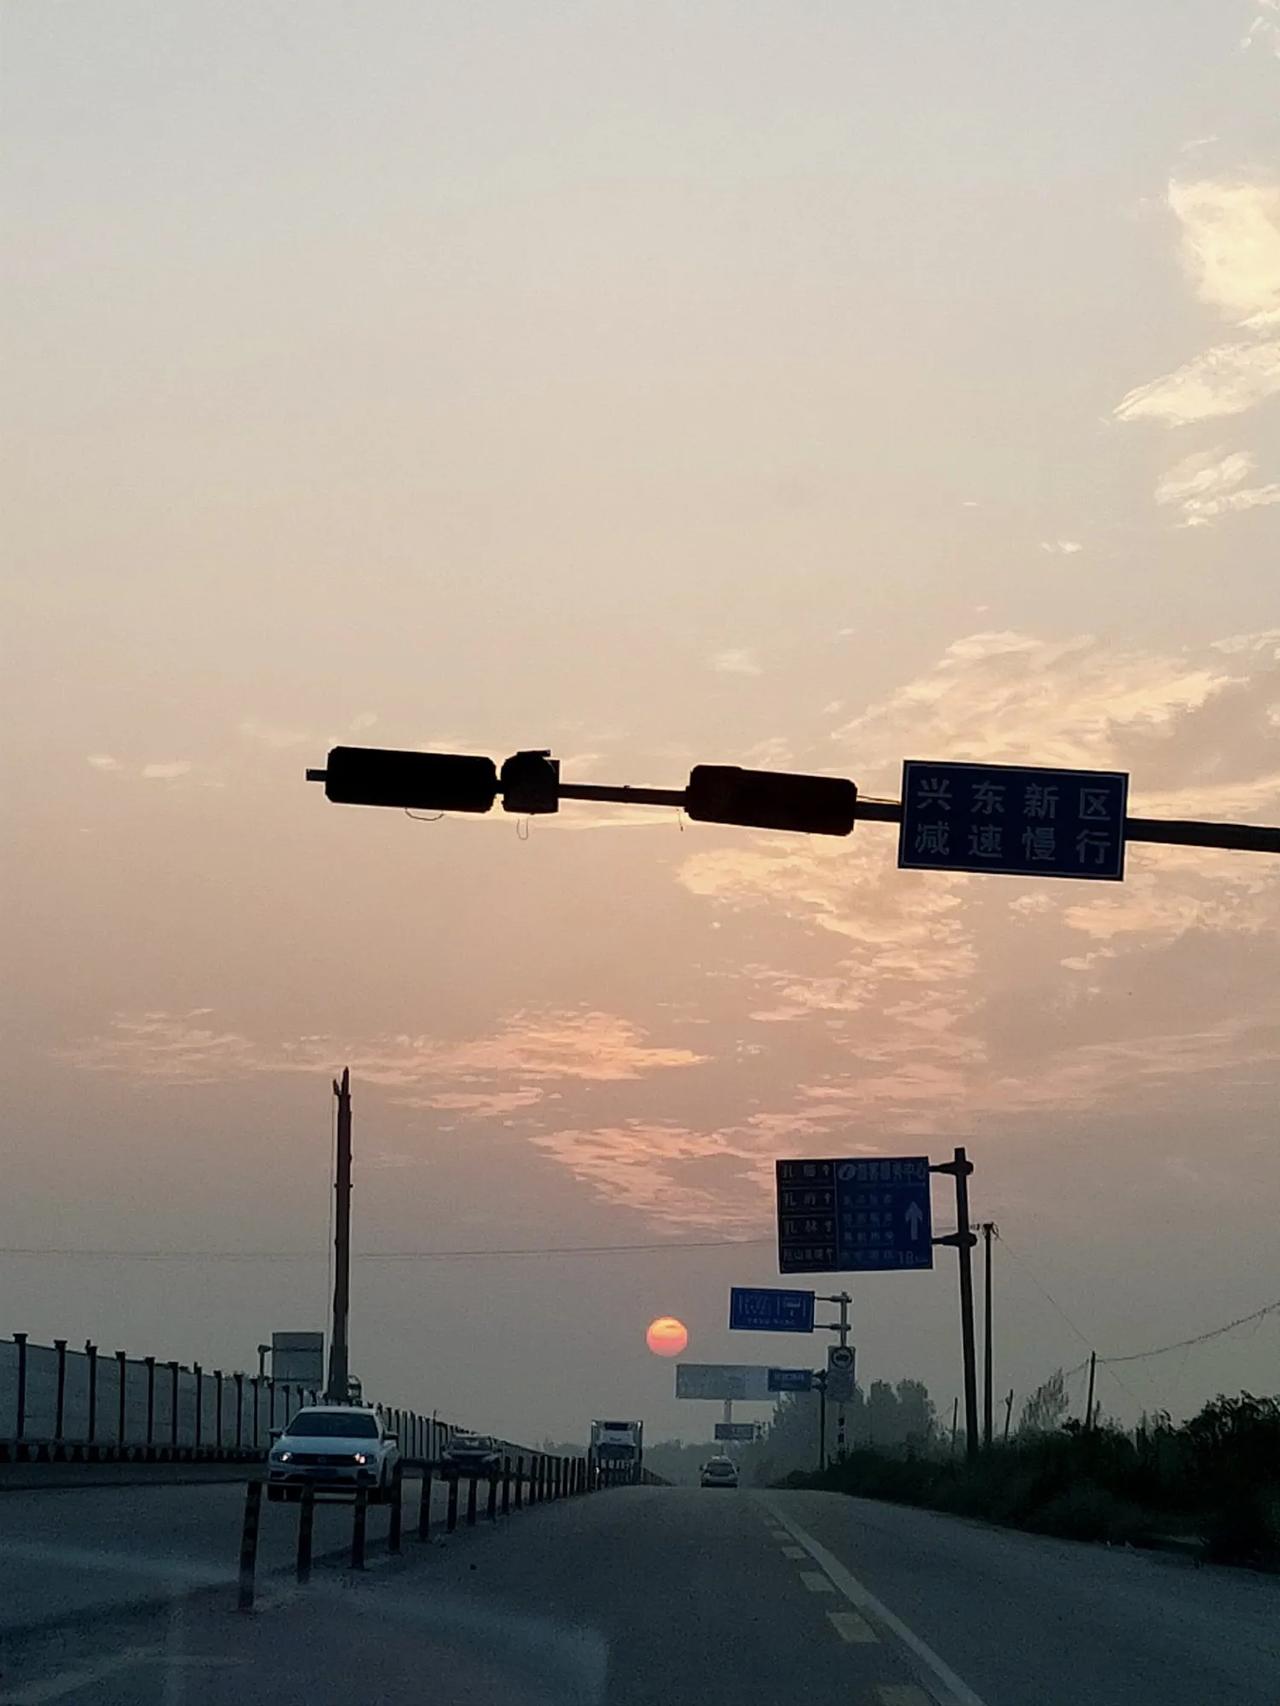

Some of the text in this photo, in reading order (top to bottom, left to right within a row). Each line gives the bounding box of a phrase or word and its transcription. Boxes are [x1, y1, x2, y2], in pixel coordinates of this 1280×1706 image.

[916, 777, 1111, 821] 兴东新区
[915, 822, 1111, 864] 减速慢行
